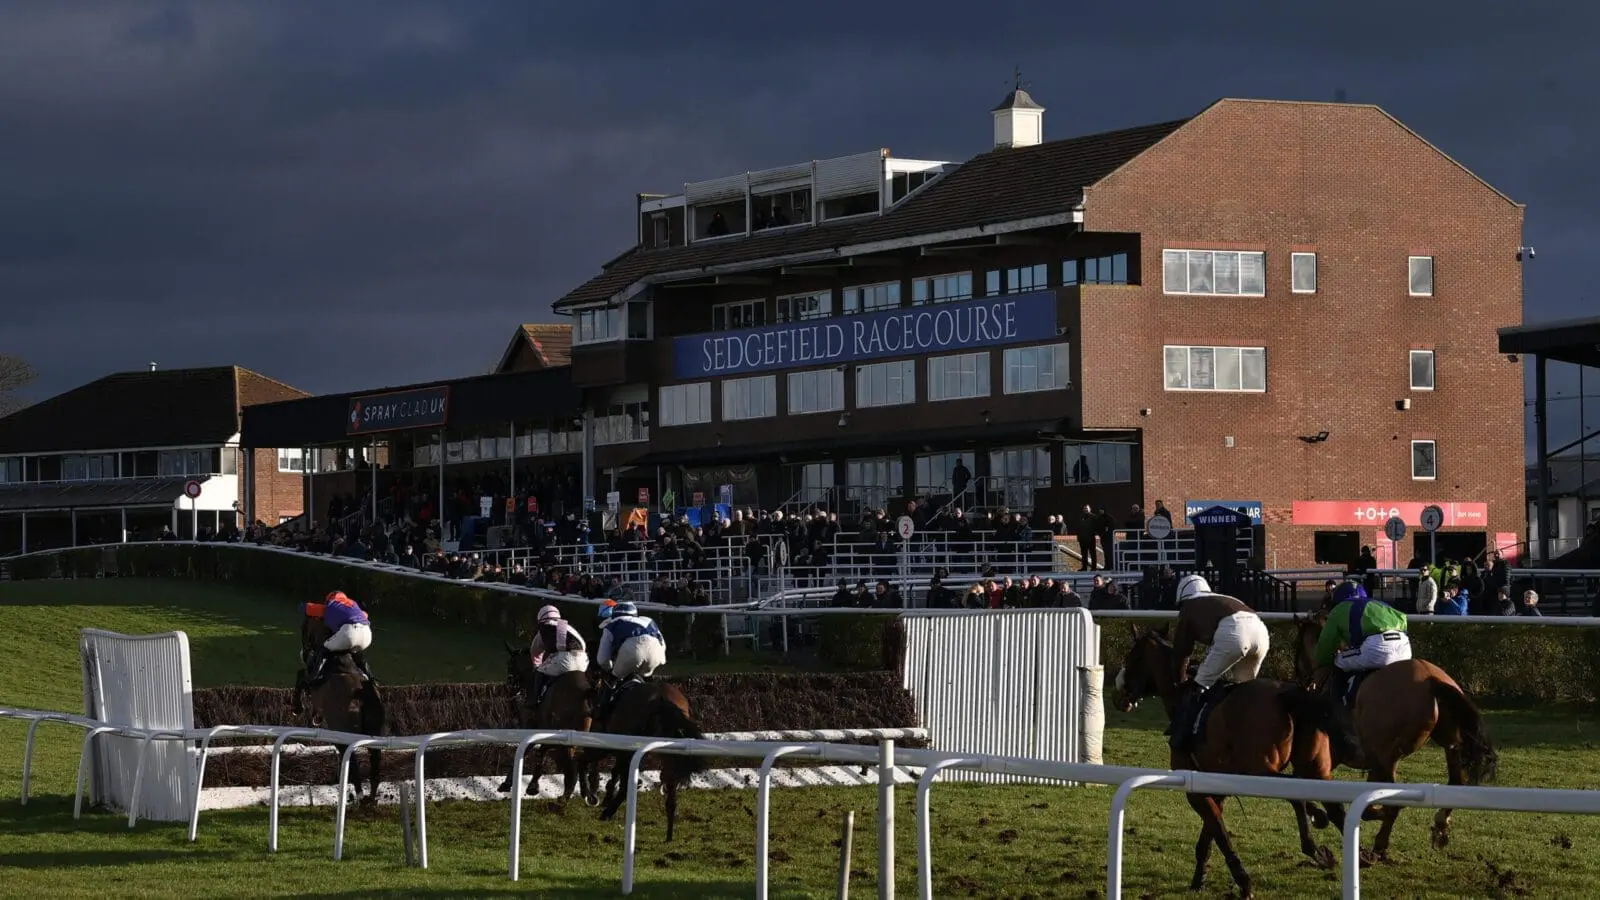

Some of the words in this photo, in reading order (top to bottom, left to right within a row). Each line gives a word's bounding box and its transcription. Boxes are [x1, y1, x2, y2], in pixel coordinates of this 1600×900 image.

[702, 324, 845, 372] SEDGEFIELD
[851, 301, 1017, 356] RACECOURSE
[363, 404, 398, 421] SPRAY
[1199, 515, 1237, 524] WINNER
[1426, 515, 1435, 527] 4
[903, 524, 909, 534] 2
